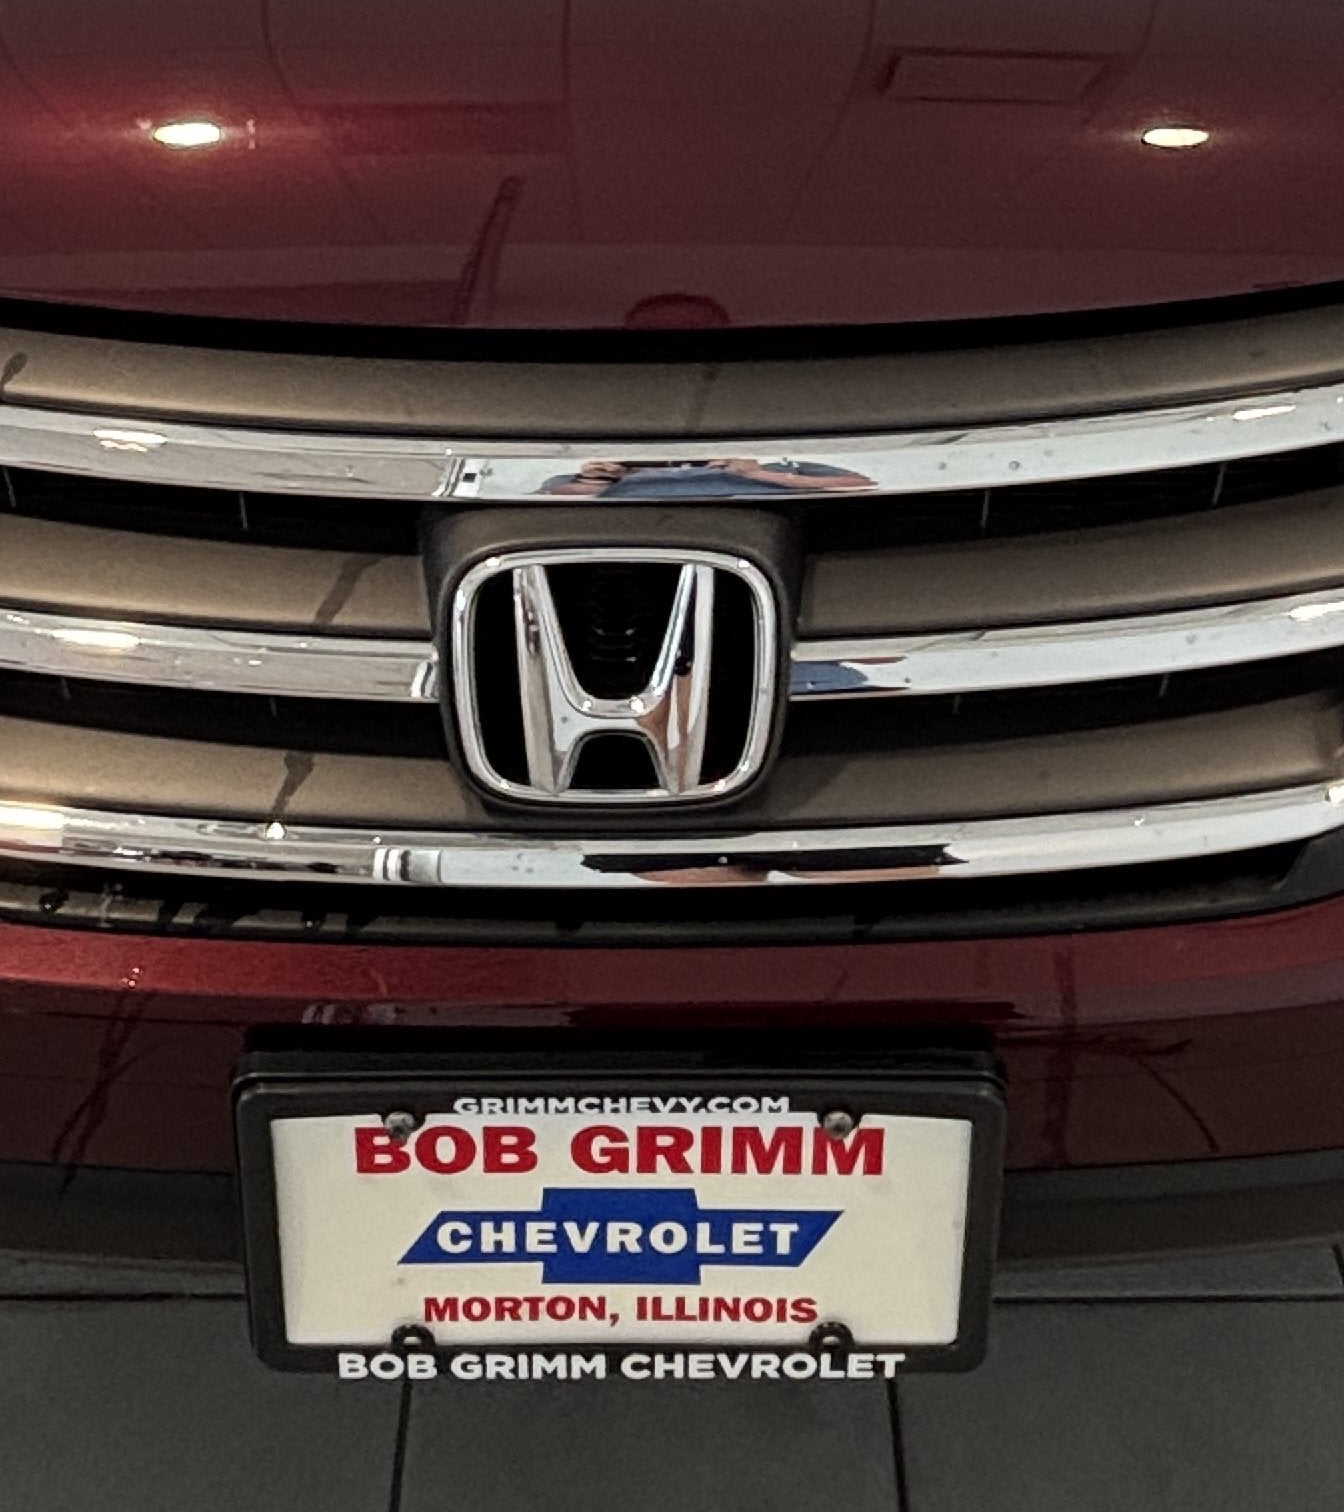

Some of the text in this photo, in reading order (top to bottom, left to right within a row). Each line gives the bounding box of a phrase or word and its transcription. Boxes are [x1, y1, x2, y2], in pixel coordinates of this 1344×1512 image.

[453, 1096, 790, 1115] GRIMMCHEVY.COM
[354, 1124, 885, 1176] BOB GRIMM
[436, 1221, 800, 1256] CHEVROLET
[423, 1296, 819, 1327] MORTON, ILLINOIS
[338, 1352, 906, 1381] BOB GRIMM CHEVROLET
